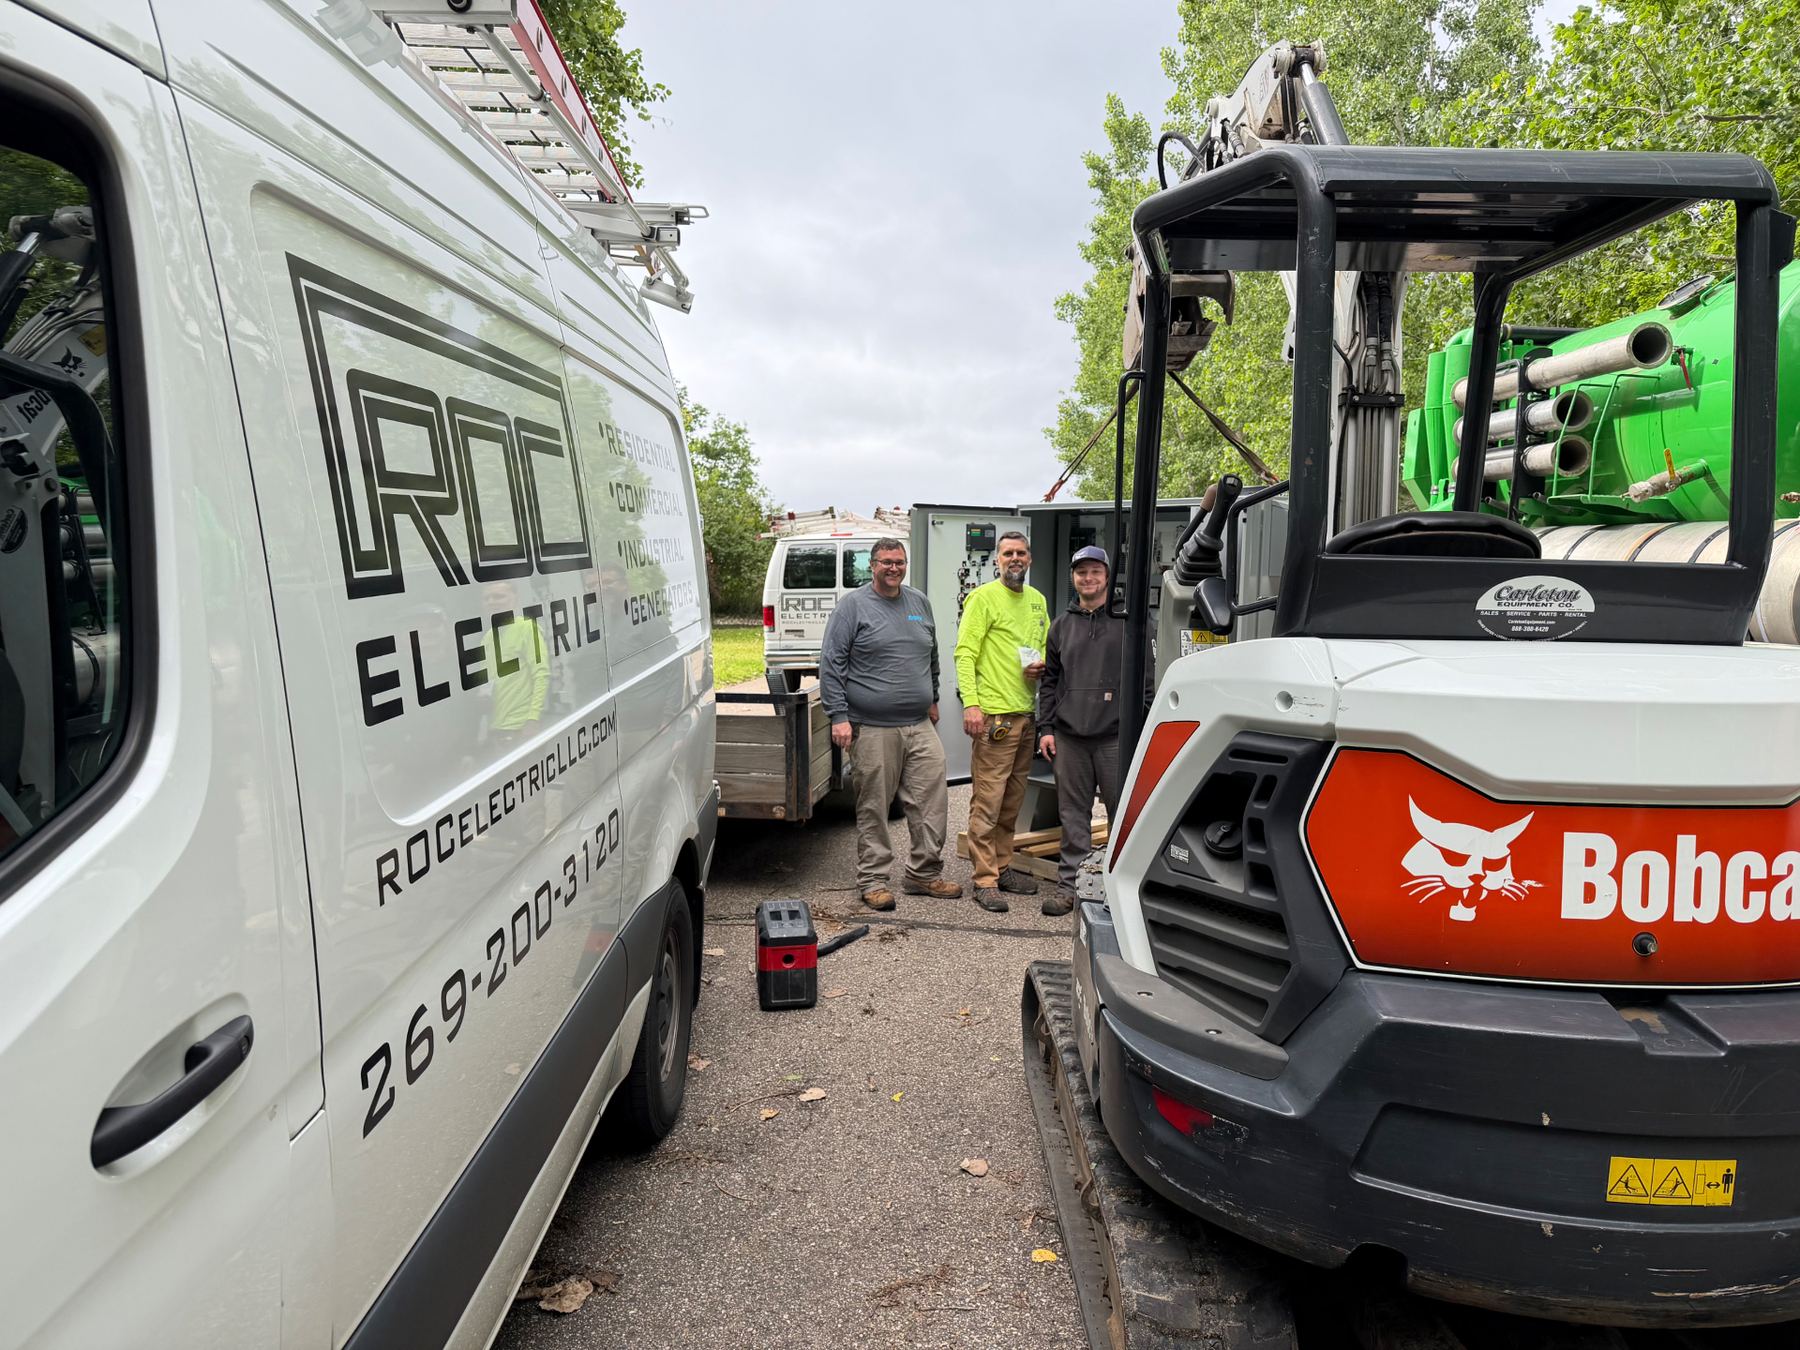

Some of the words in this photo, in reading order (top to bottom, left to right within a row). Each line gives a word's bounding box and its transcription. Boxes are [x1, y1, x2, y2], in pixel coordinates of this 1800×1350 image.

[325, 330, 593, 598] ROC
[604, 423, 676, 473] RESIDENTIAL
[615, 482, 684, 517] COMMERCIAL
[623, 538, 684, 570] INDUSTRIAL
[631, 581, 694, 626] GENERATORS
[783, 594, 835, 611] ROC
[1493, 584, 1582, 602] Carleton
[355, 592, 601, 728] ELECTRIC
[376, 709, 616, 907] ROCELECTRICLLC.COM
[1560, 831, 1800, 924] Bobca
[361, 807, 620, 1140] 269-200-3120
